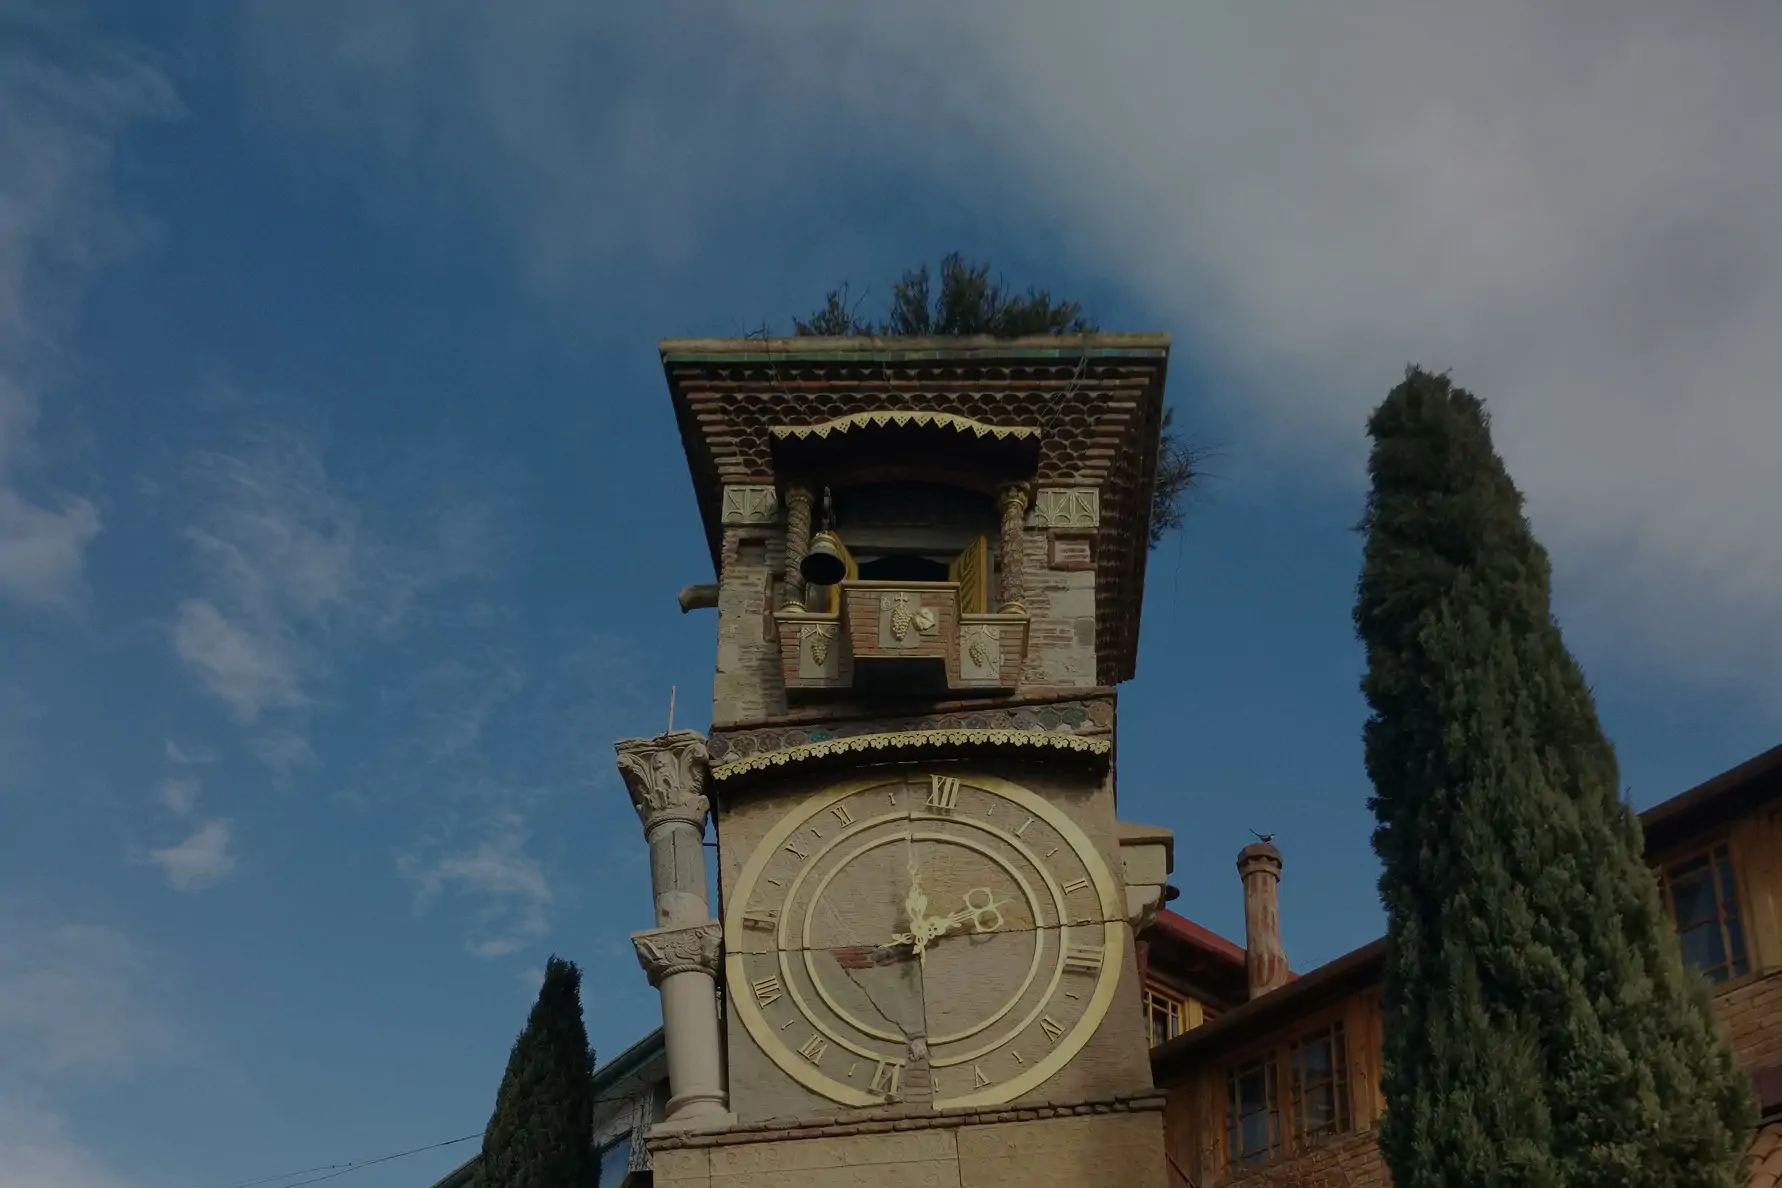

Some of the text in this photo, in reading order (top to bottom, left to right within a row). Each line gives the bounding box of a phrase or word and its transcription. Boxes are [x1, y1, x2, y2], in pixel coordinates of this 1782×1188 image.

[926, 773, 961, 809] XII
[830, 806, 856, 828] XI
[1061, 879, 1089, 895] II
[1040, 1015, 1066, 1044] IV
[797, 1033, 828, 1067] VII
[974, 1064, 992, 1089] V
